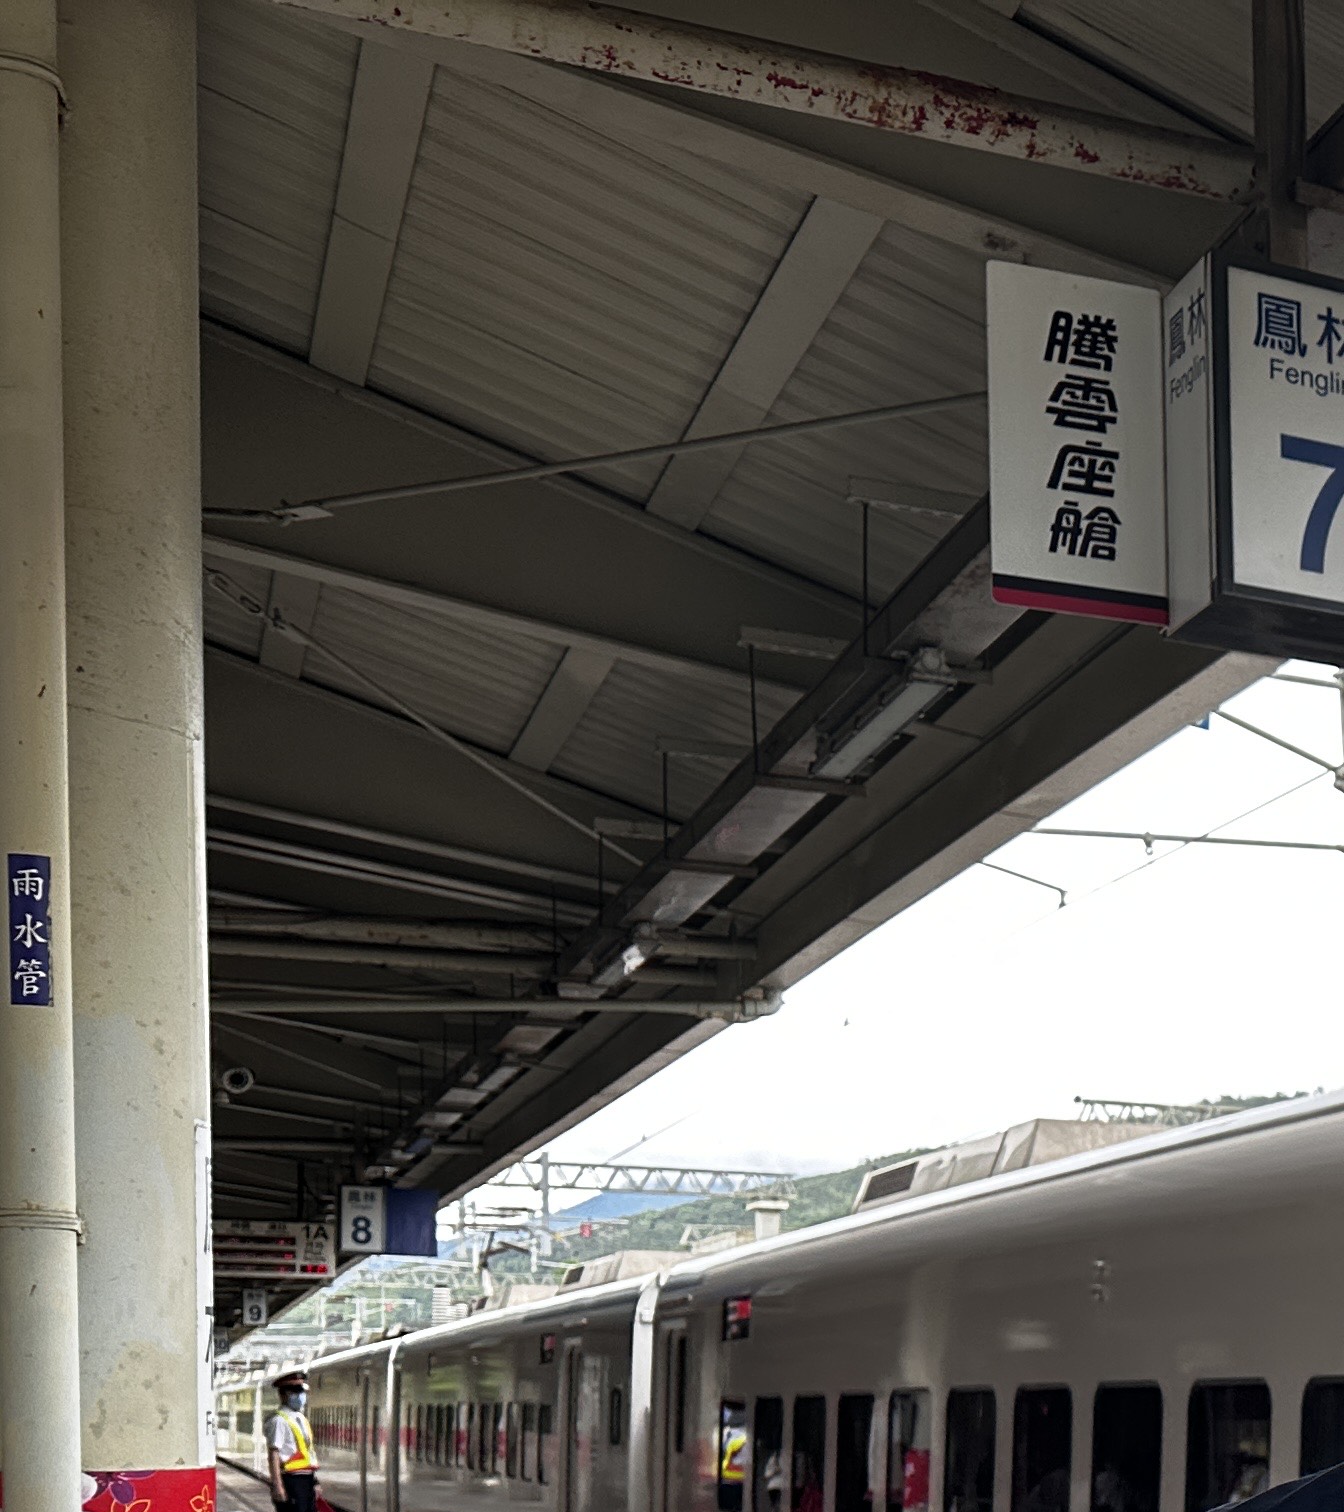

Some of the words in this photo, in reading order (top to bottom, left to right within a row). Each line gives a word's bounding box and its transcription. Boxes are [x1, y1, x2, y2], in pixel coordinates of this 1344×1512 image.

[1044, 311, 1122, 561] 騰雲座艙
[13, 869, 48, 996] 雨水管
[303, 1224, 329, 1240] 1A
[351, 1216, 372, 1244] 8
[249, 1304, 263, 1322] 9
